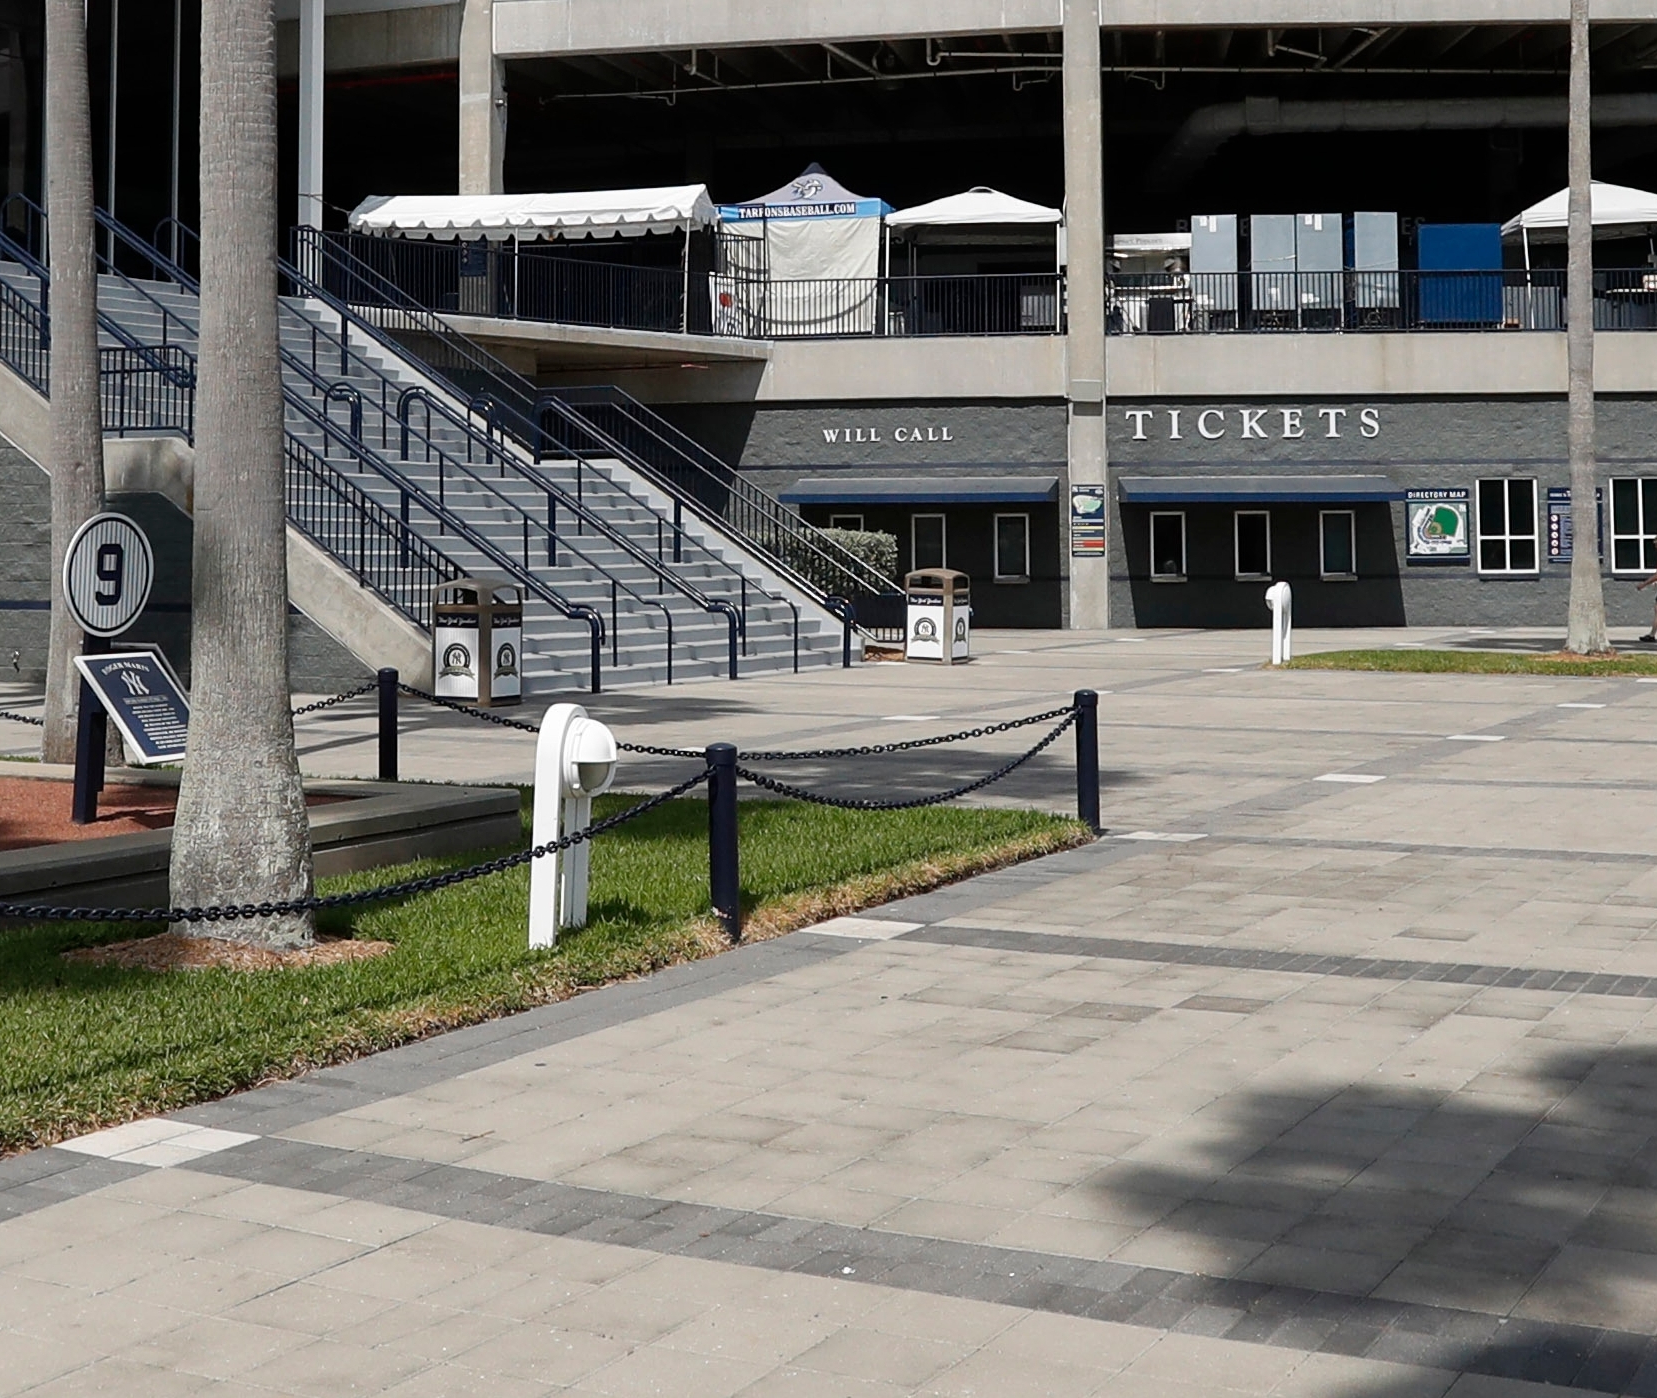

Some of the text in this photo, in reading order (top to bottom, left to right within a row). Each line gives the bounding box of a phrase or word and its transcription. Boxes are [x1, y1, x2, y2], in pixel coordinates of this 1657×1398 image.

[823, 427, 954, 443] WILL CALL
[1125, 408, 1381, 440] TICKETS
[1407, 491, 1448, 499] DIRECTORY
[94, 543, 124, 606] 9
